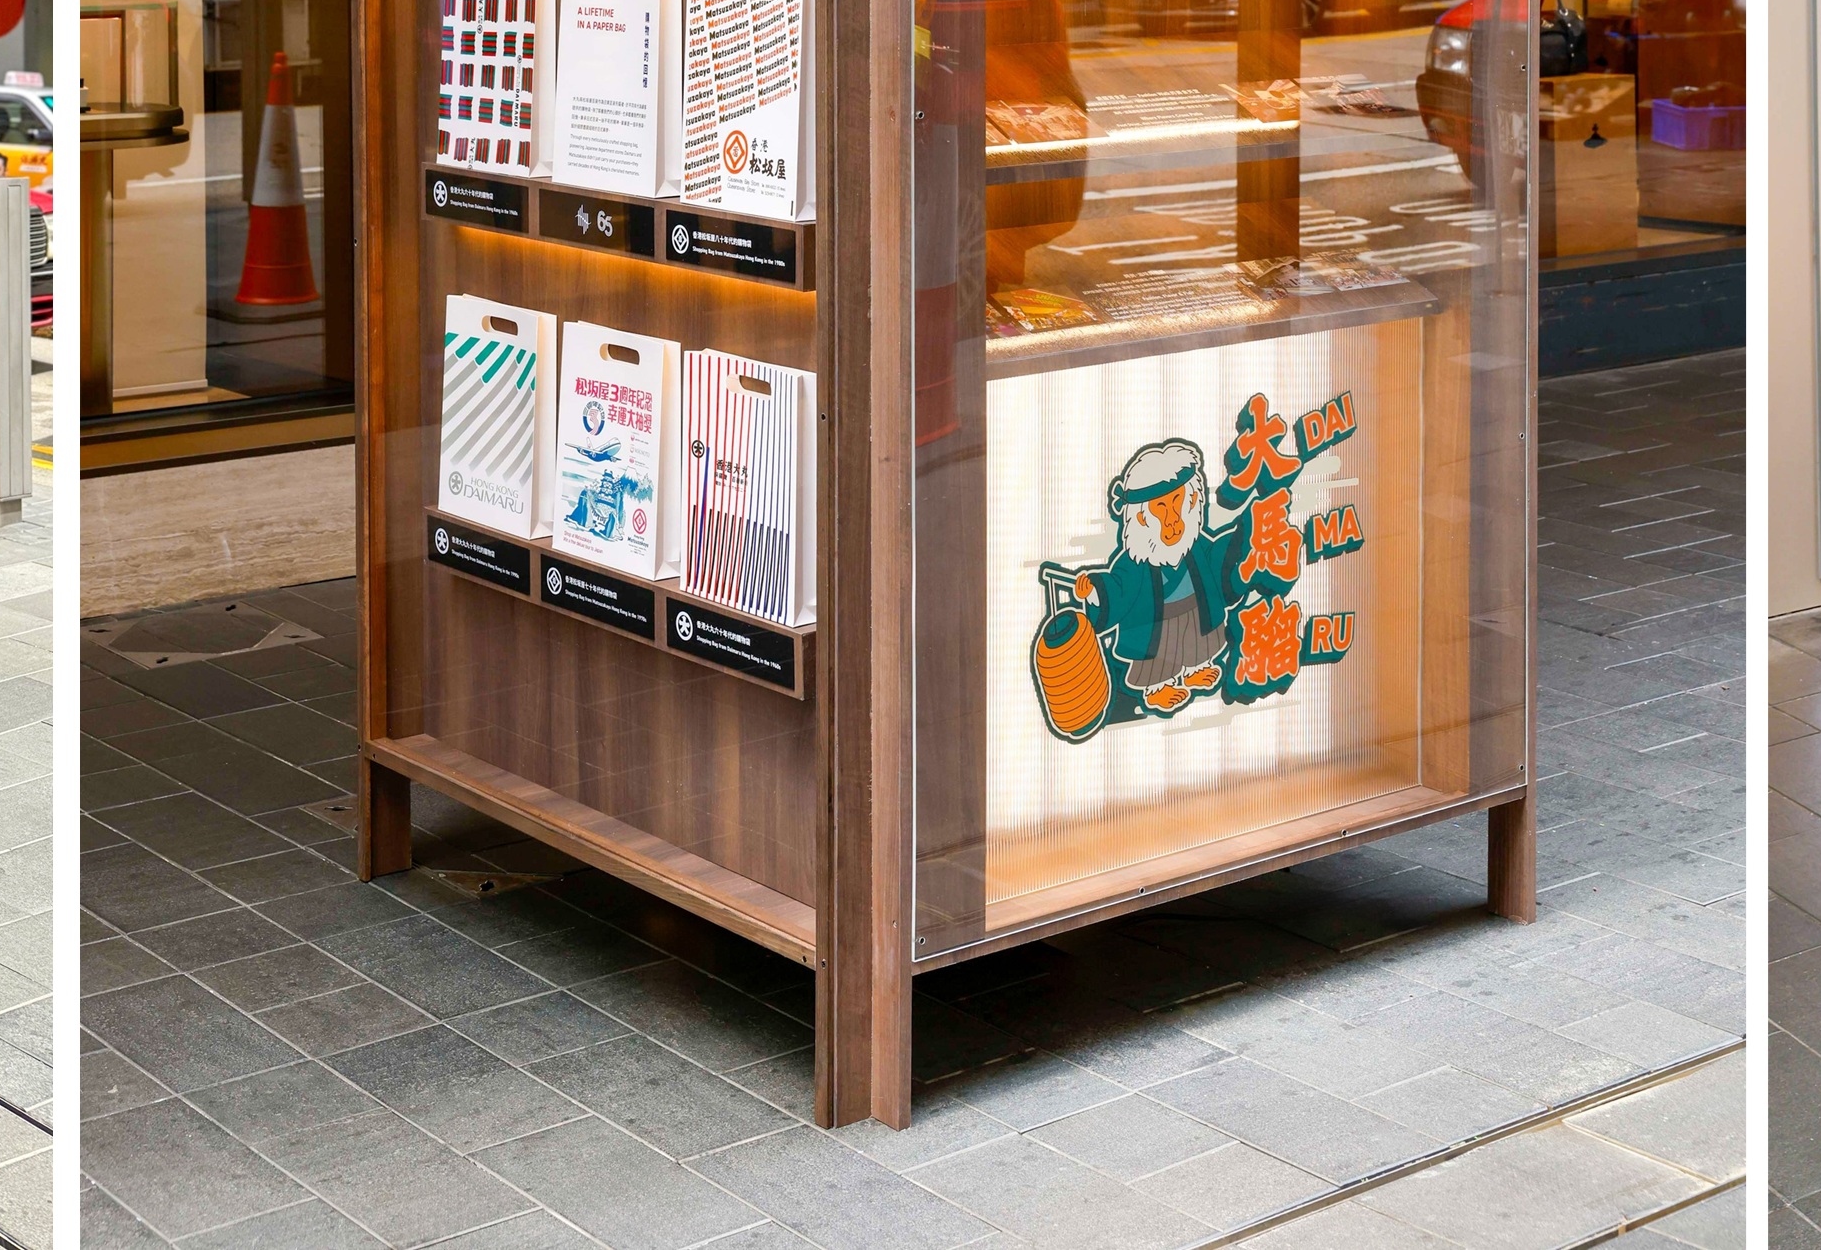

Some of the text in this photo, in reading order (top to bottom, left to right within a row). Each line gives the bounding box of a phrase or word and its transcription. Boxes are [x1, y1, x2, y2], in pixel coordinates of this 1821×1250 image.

[584, 7, 615, 18] LIFETIME
[708, 8, 748, 29] Matsuzakaya
[752, 1, 784, 22] Matsuzakaya
[577, 20, 585, 29] IN
[593, 21, 614, 31] PAPER
[614, 23, 626, 33] BAG
[710, 19, 749, 41] Matsuzakaya
[754, 33, 786, 55] Matsuzakaya
[750, 137, 768, 152] 香港
[749, 153, 786, 180] 松坂屋
[596, 210, 613, 237] 65
[1302, 391, 1357, 445] DAI
[715, 459, 749, 479] 香港大丸
[470, 476, 519, 499] HONG KONG
[463, 483, 524, 515] DAIMARU
[1313, 507, 1362, 554] MA
[1310, 613, 1355, 655] RU
